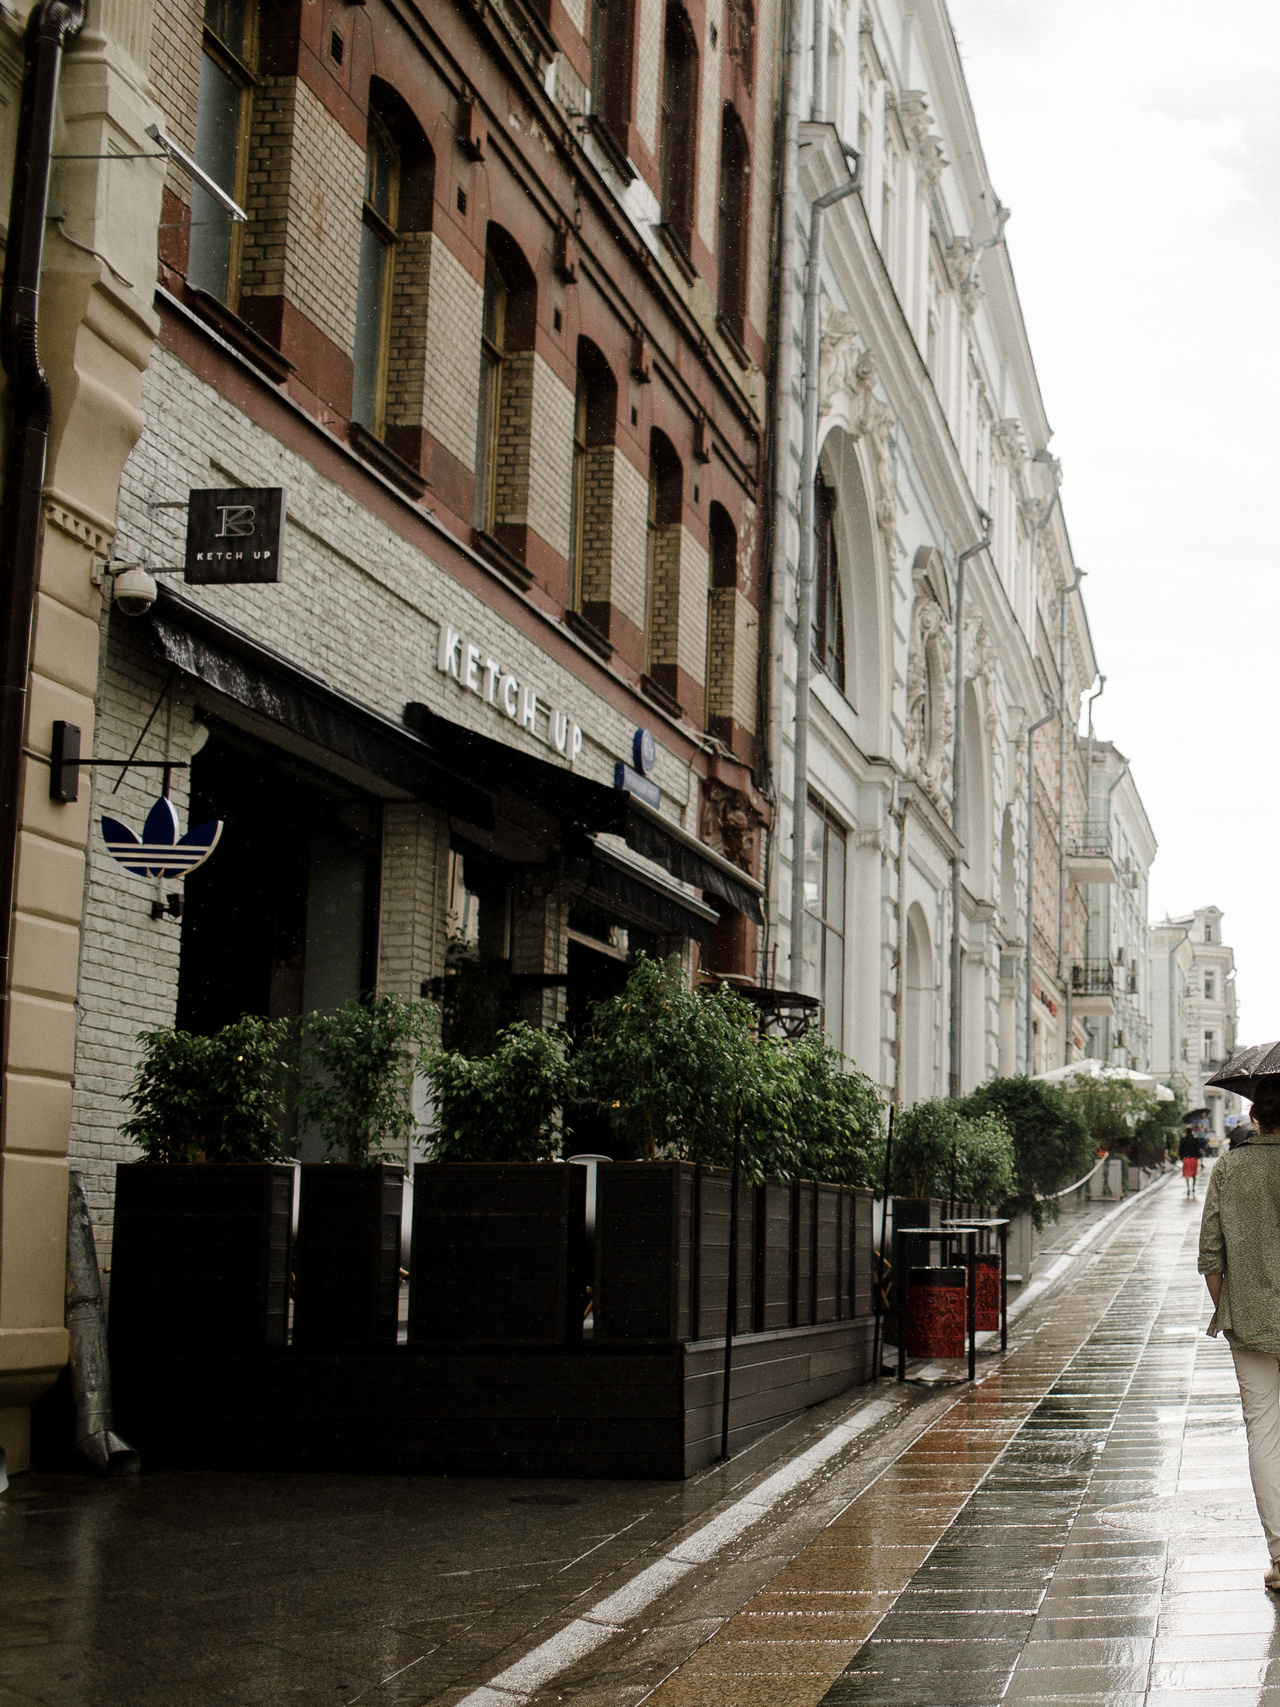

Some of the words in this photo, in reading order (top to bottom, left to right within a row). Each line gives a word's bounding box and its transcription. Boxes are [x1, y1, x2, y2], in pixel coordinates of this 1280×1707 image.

[196, 552, 243, 561] KETCH
[253, 551, 271, 559] UP
[438, 626, 537, 733] KETCH
[550, 709, 582, 762] UP
